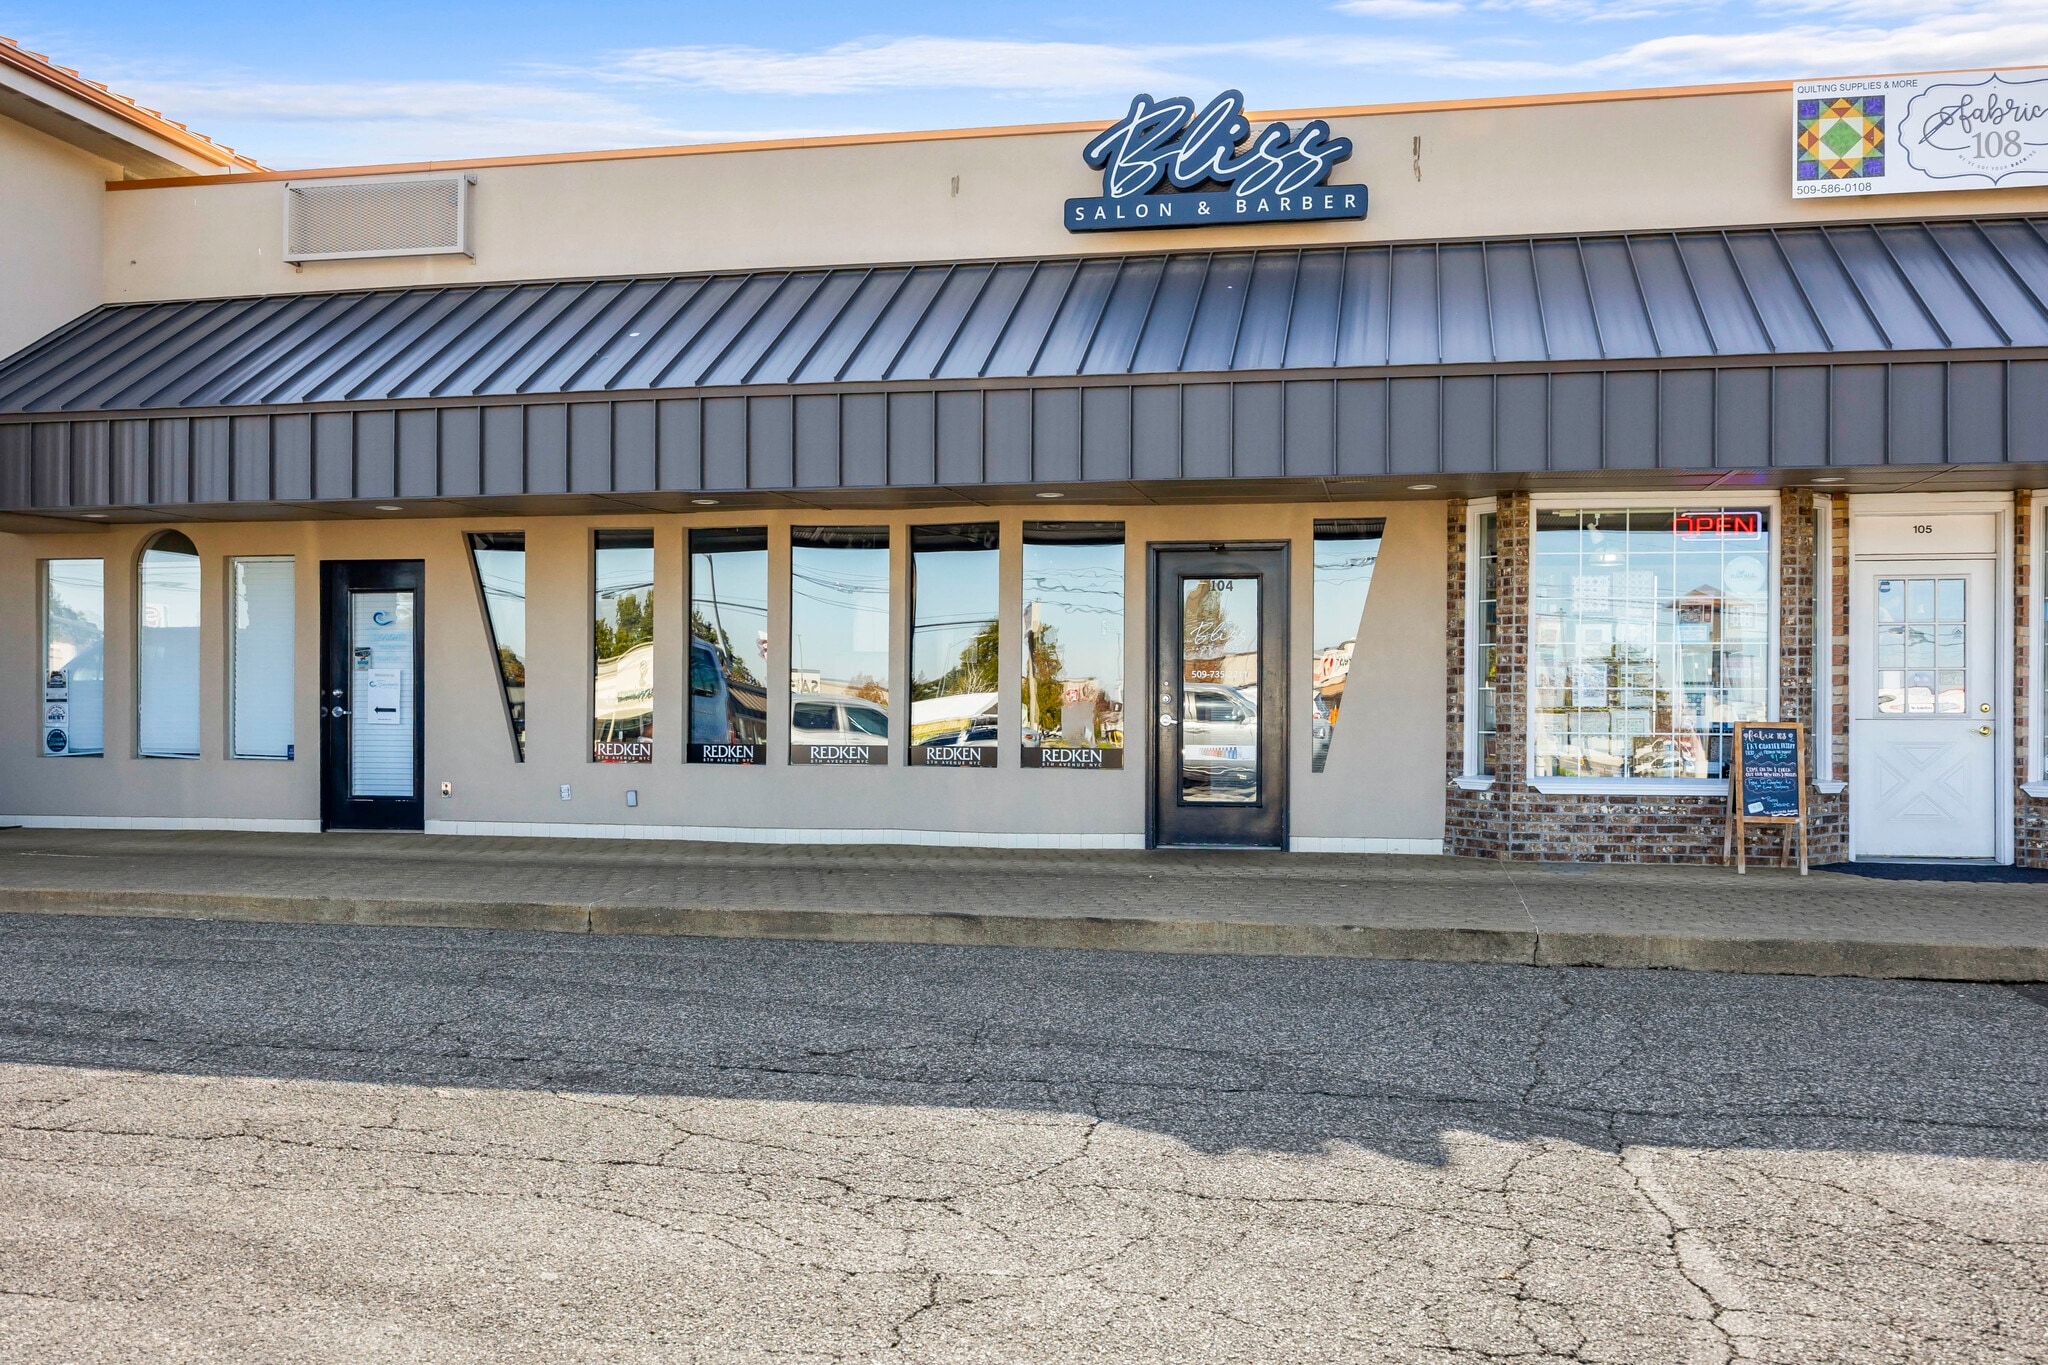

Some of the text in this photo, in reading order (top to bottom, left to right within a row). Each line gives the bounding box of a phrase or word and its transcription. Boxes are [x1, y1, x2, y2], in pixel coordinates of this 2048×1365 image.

[1797, 79, 1918, 94] QUILTING SUPPLIES & MORE
[1091, 97, 1343, 198] Bliss
[1971, 129, 2022, 160] 108
[1796, 182, 1872, 195] 509-586-0108
[1075, 194, 1356, 221] SALON & BARBER
[1672, 516, 1755, 537] OPEN
[1912, 525, 1933, 534] 105
[1210, 580, 1233, 591] 104
[1190, 621, 1247, 645] Bliss
[1748, 730, 1774, 742] fabric
[598, 743, 650, 756] REDKEN
[703, 745, 754, 758] REDKEN
[810, 746, 869, 759] REDKEN
[926, 747, 981, 760] REDKEN
[1042, 749, 1103, 762] REDKEN
